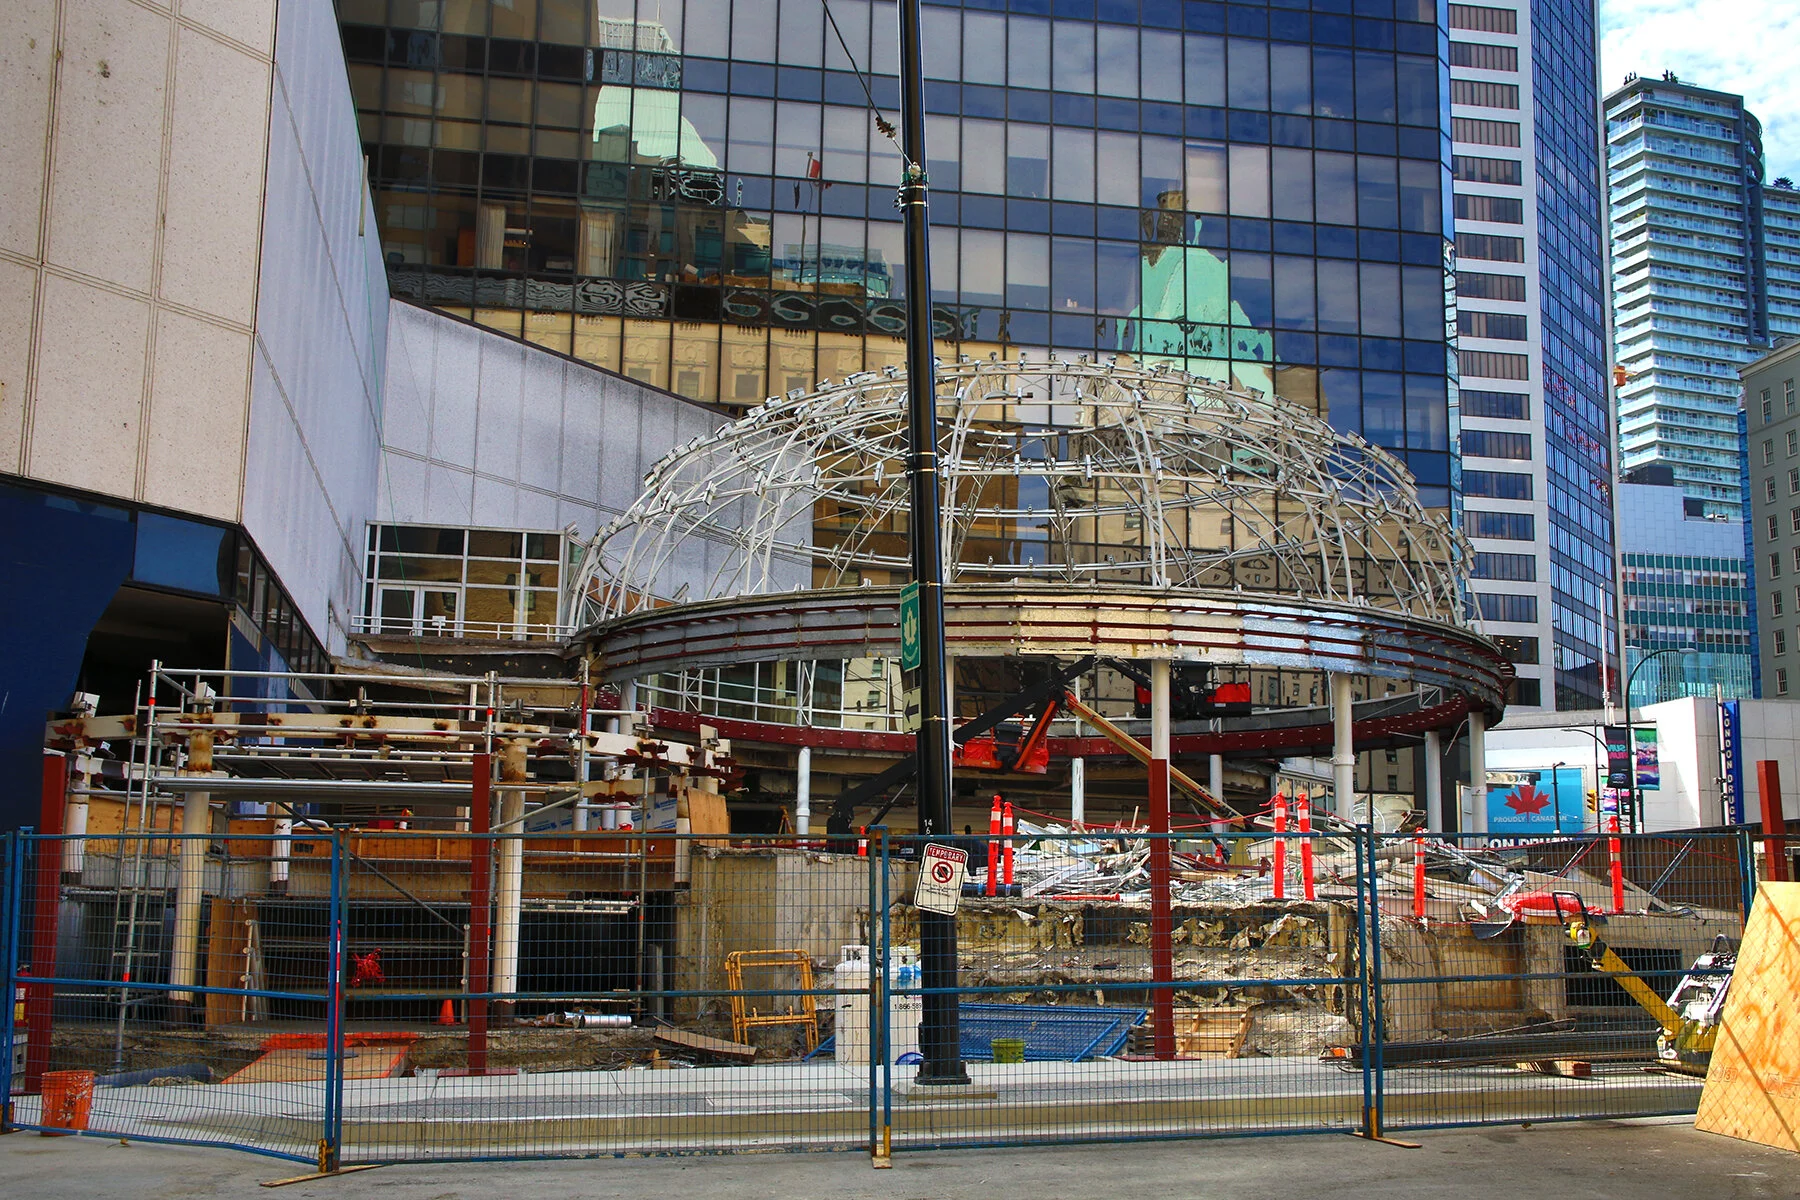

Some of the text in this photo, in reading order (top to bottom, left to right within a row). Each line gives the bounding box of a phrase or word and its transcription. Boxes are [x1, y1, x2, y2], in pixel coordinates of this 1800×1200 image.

[1723, 708, 1736, 825] LONDON DRUGS
[929, 847, 964, 861] TEMPORARY
